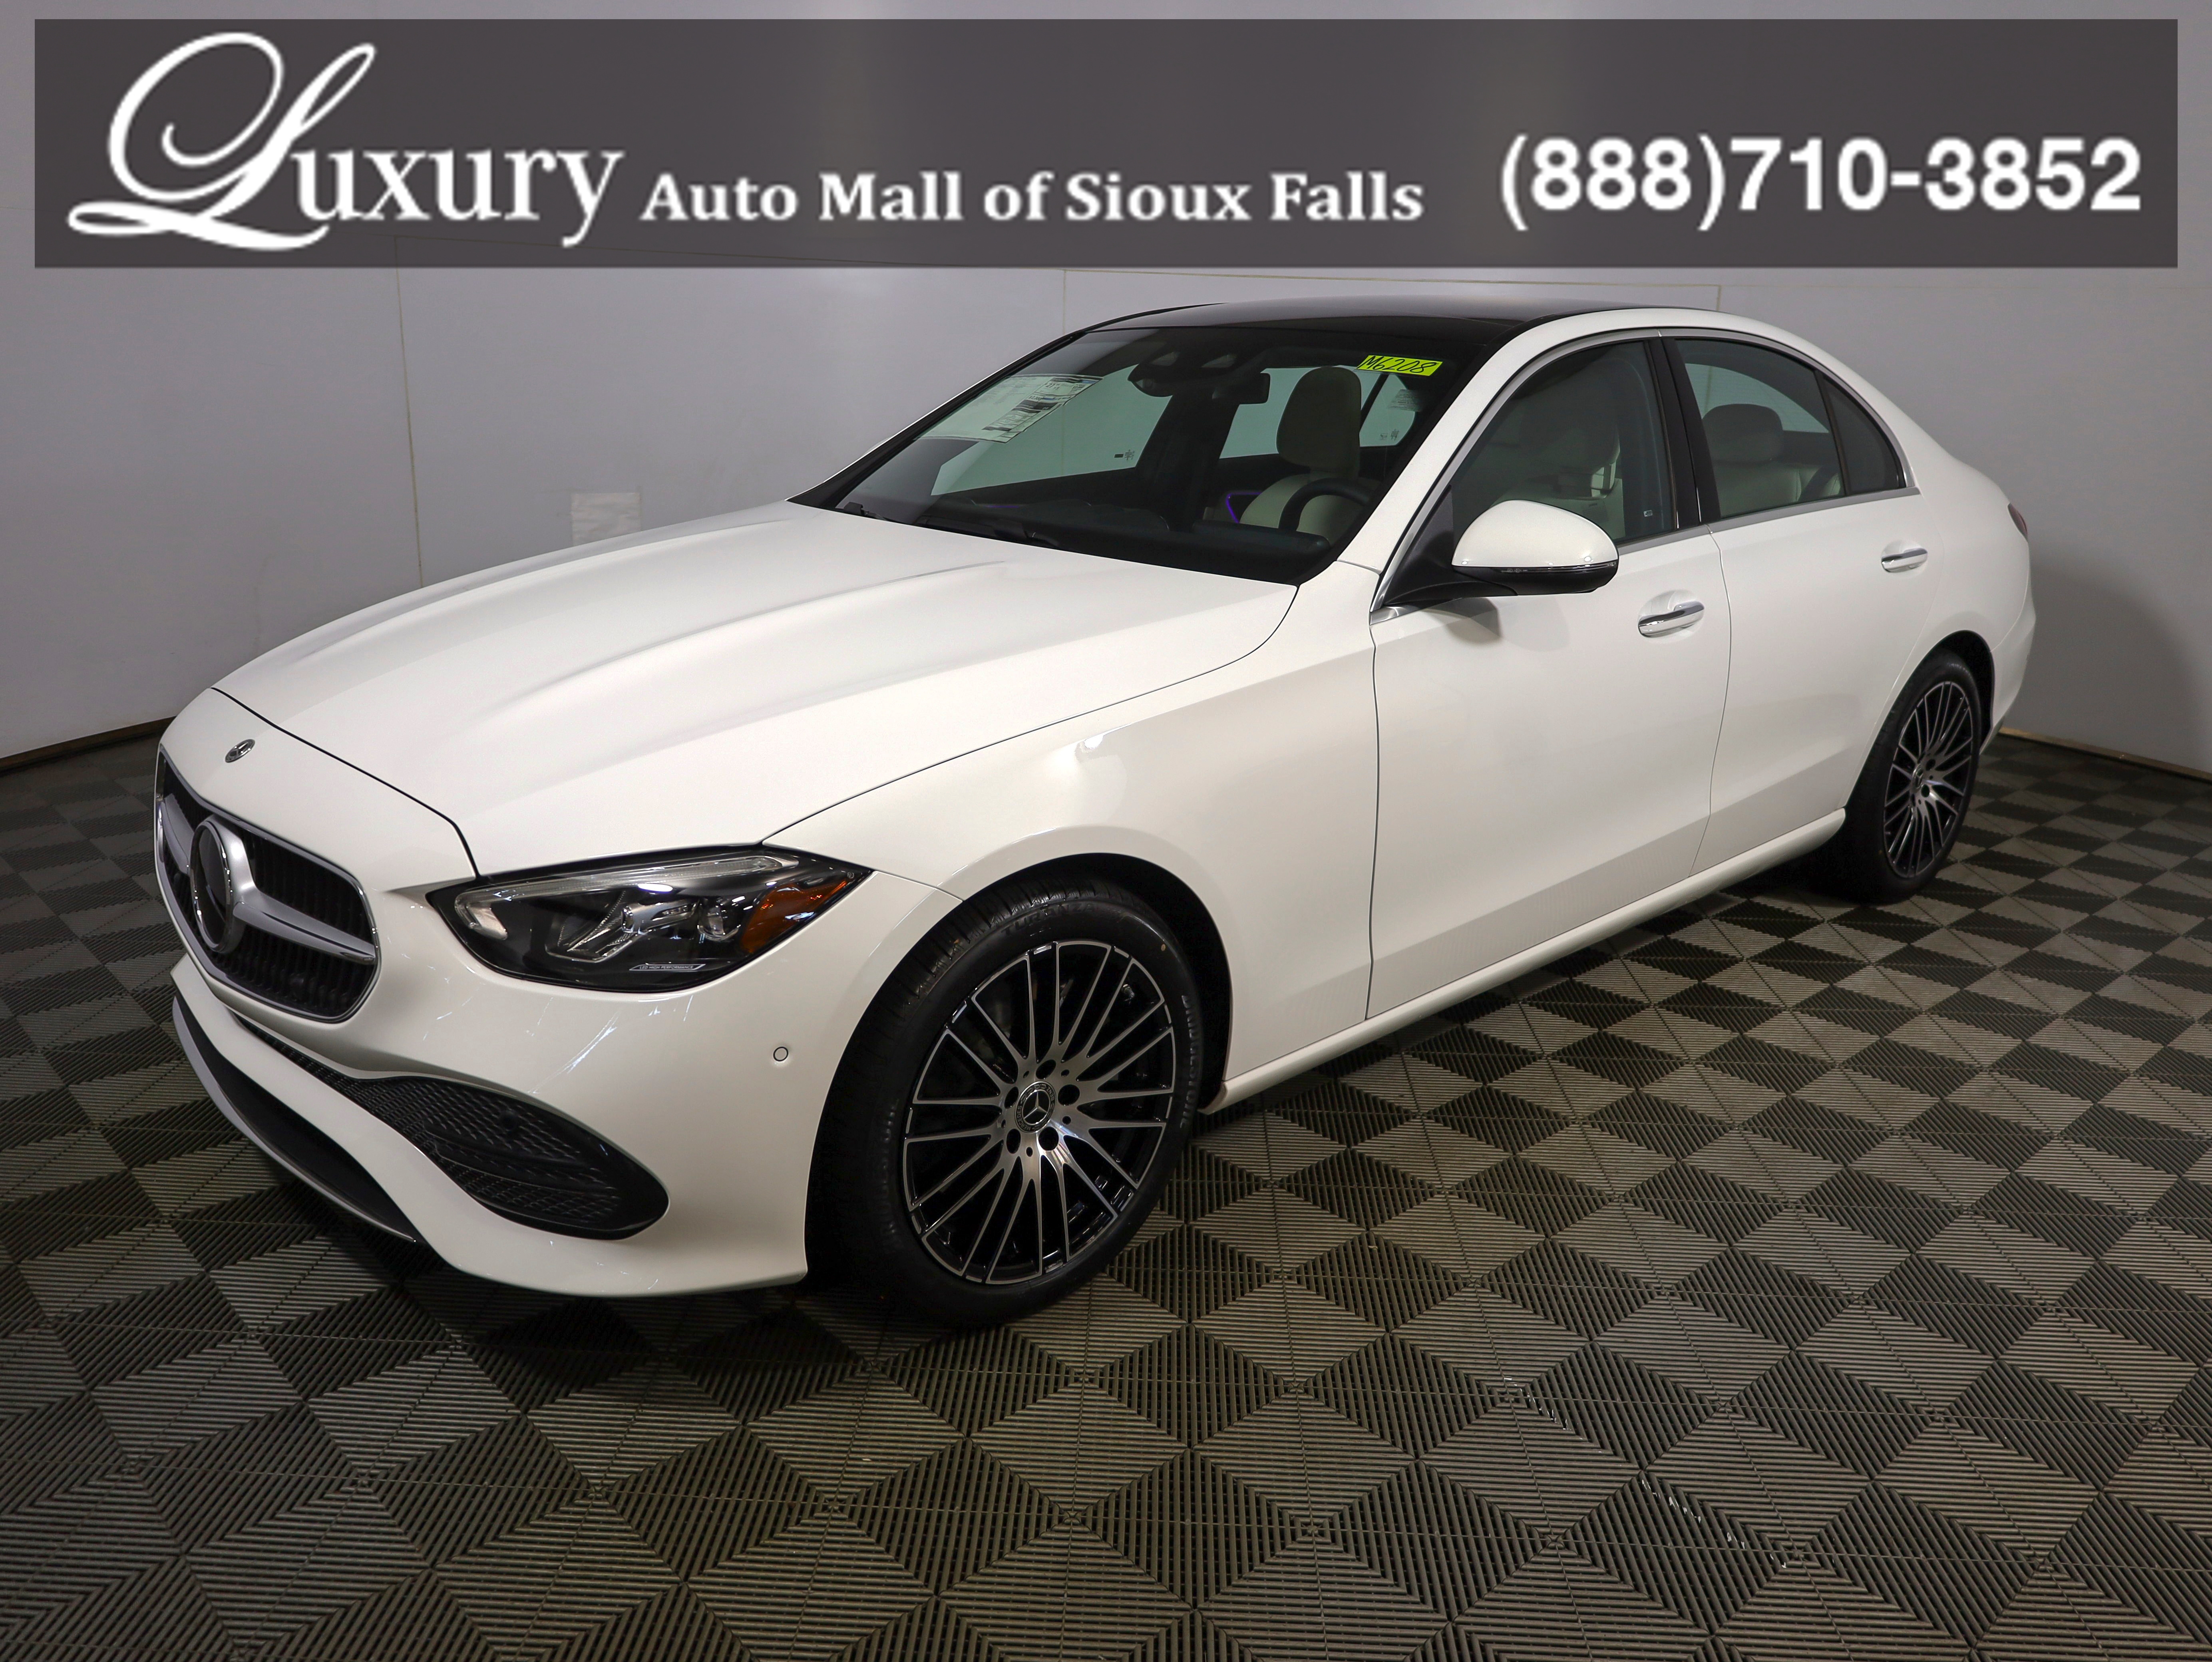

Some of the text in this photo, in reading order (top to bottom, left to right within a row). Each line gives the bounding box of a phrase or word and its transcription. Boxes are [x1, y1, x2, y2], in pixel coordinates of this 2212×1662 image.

[1357, 356, 1438, 373] M6208
[1046, 1087, 1055, 1101] BENZ
[1016, 1105, 1031, 1131] MERCEDES
